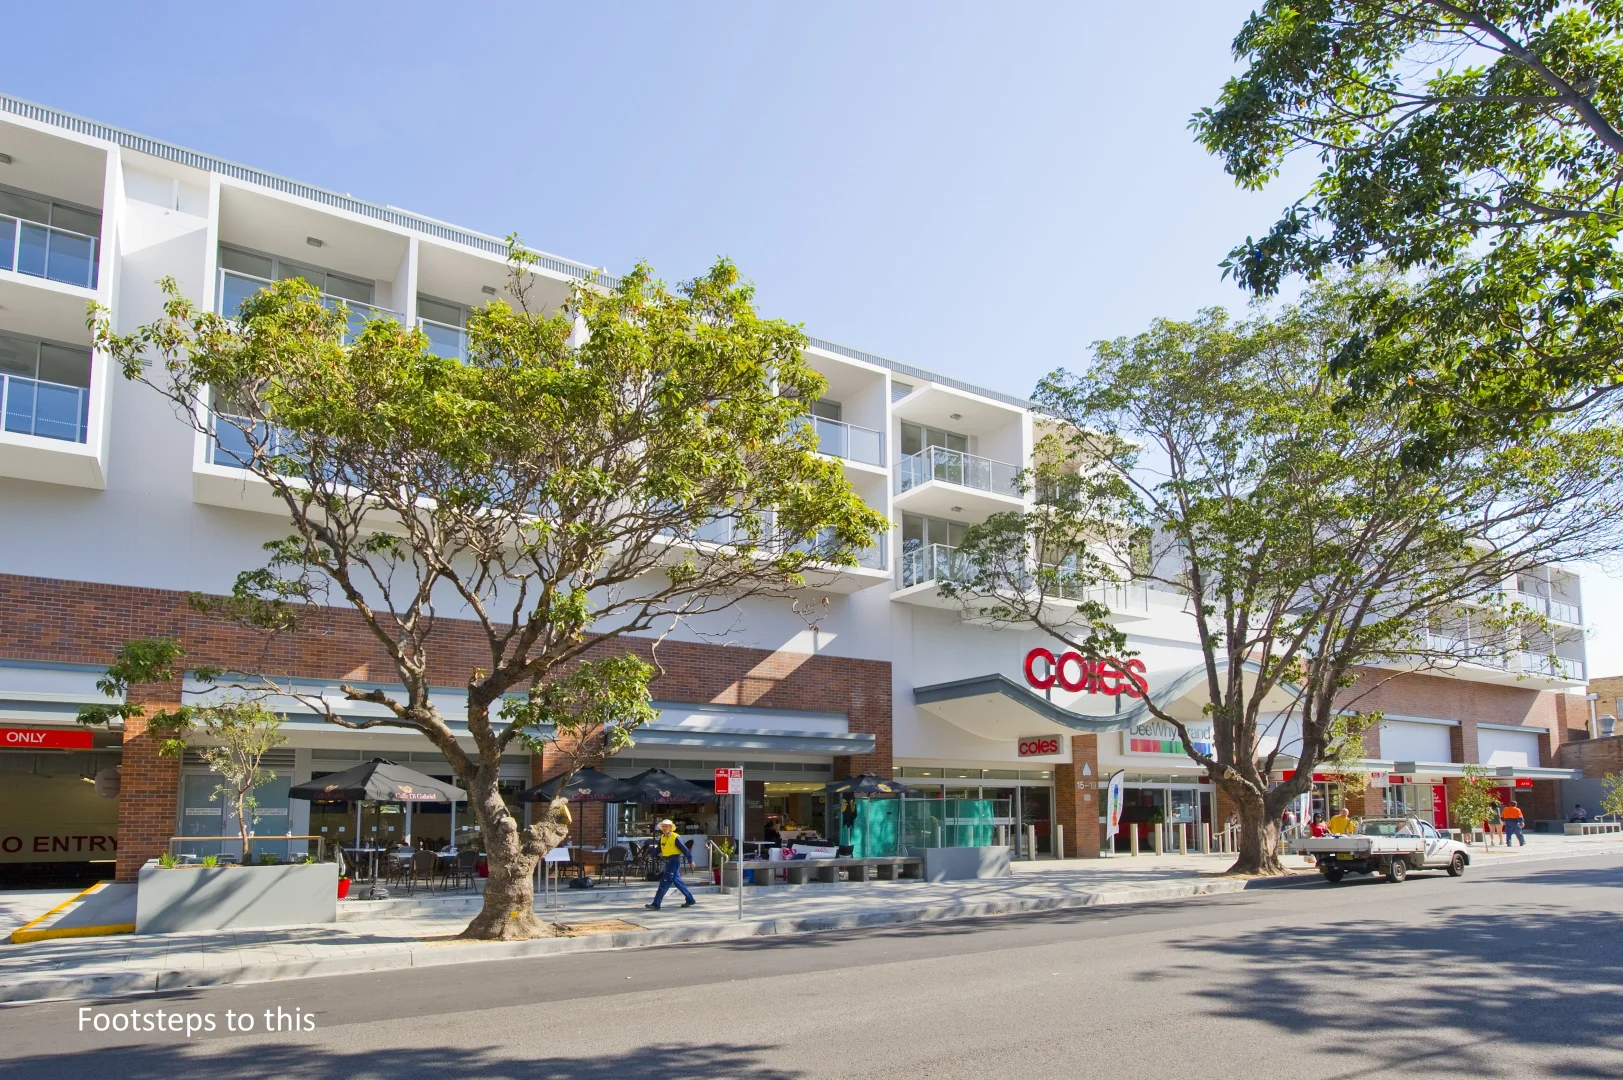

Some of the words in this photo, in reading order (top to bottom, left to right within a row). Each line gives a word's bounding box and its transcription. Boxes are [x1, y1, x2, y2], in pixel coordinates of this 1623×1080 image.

[1023, 647, 1149, 699] coles
[6, 731, 47, 743] ONLY
[1019, 738, 1058, 755] coles
[32, 835, 118, 853] ENTRY
